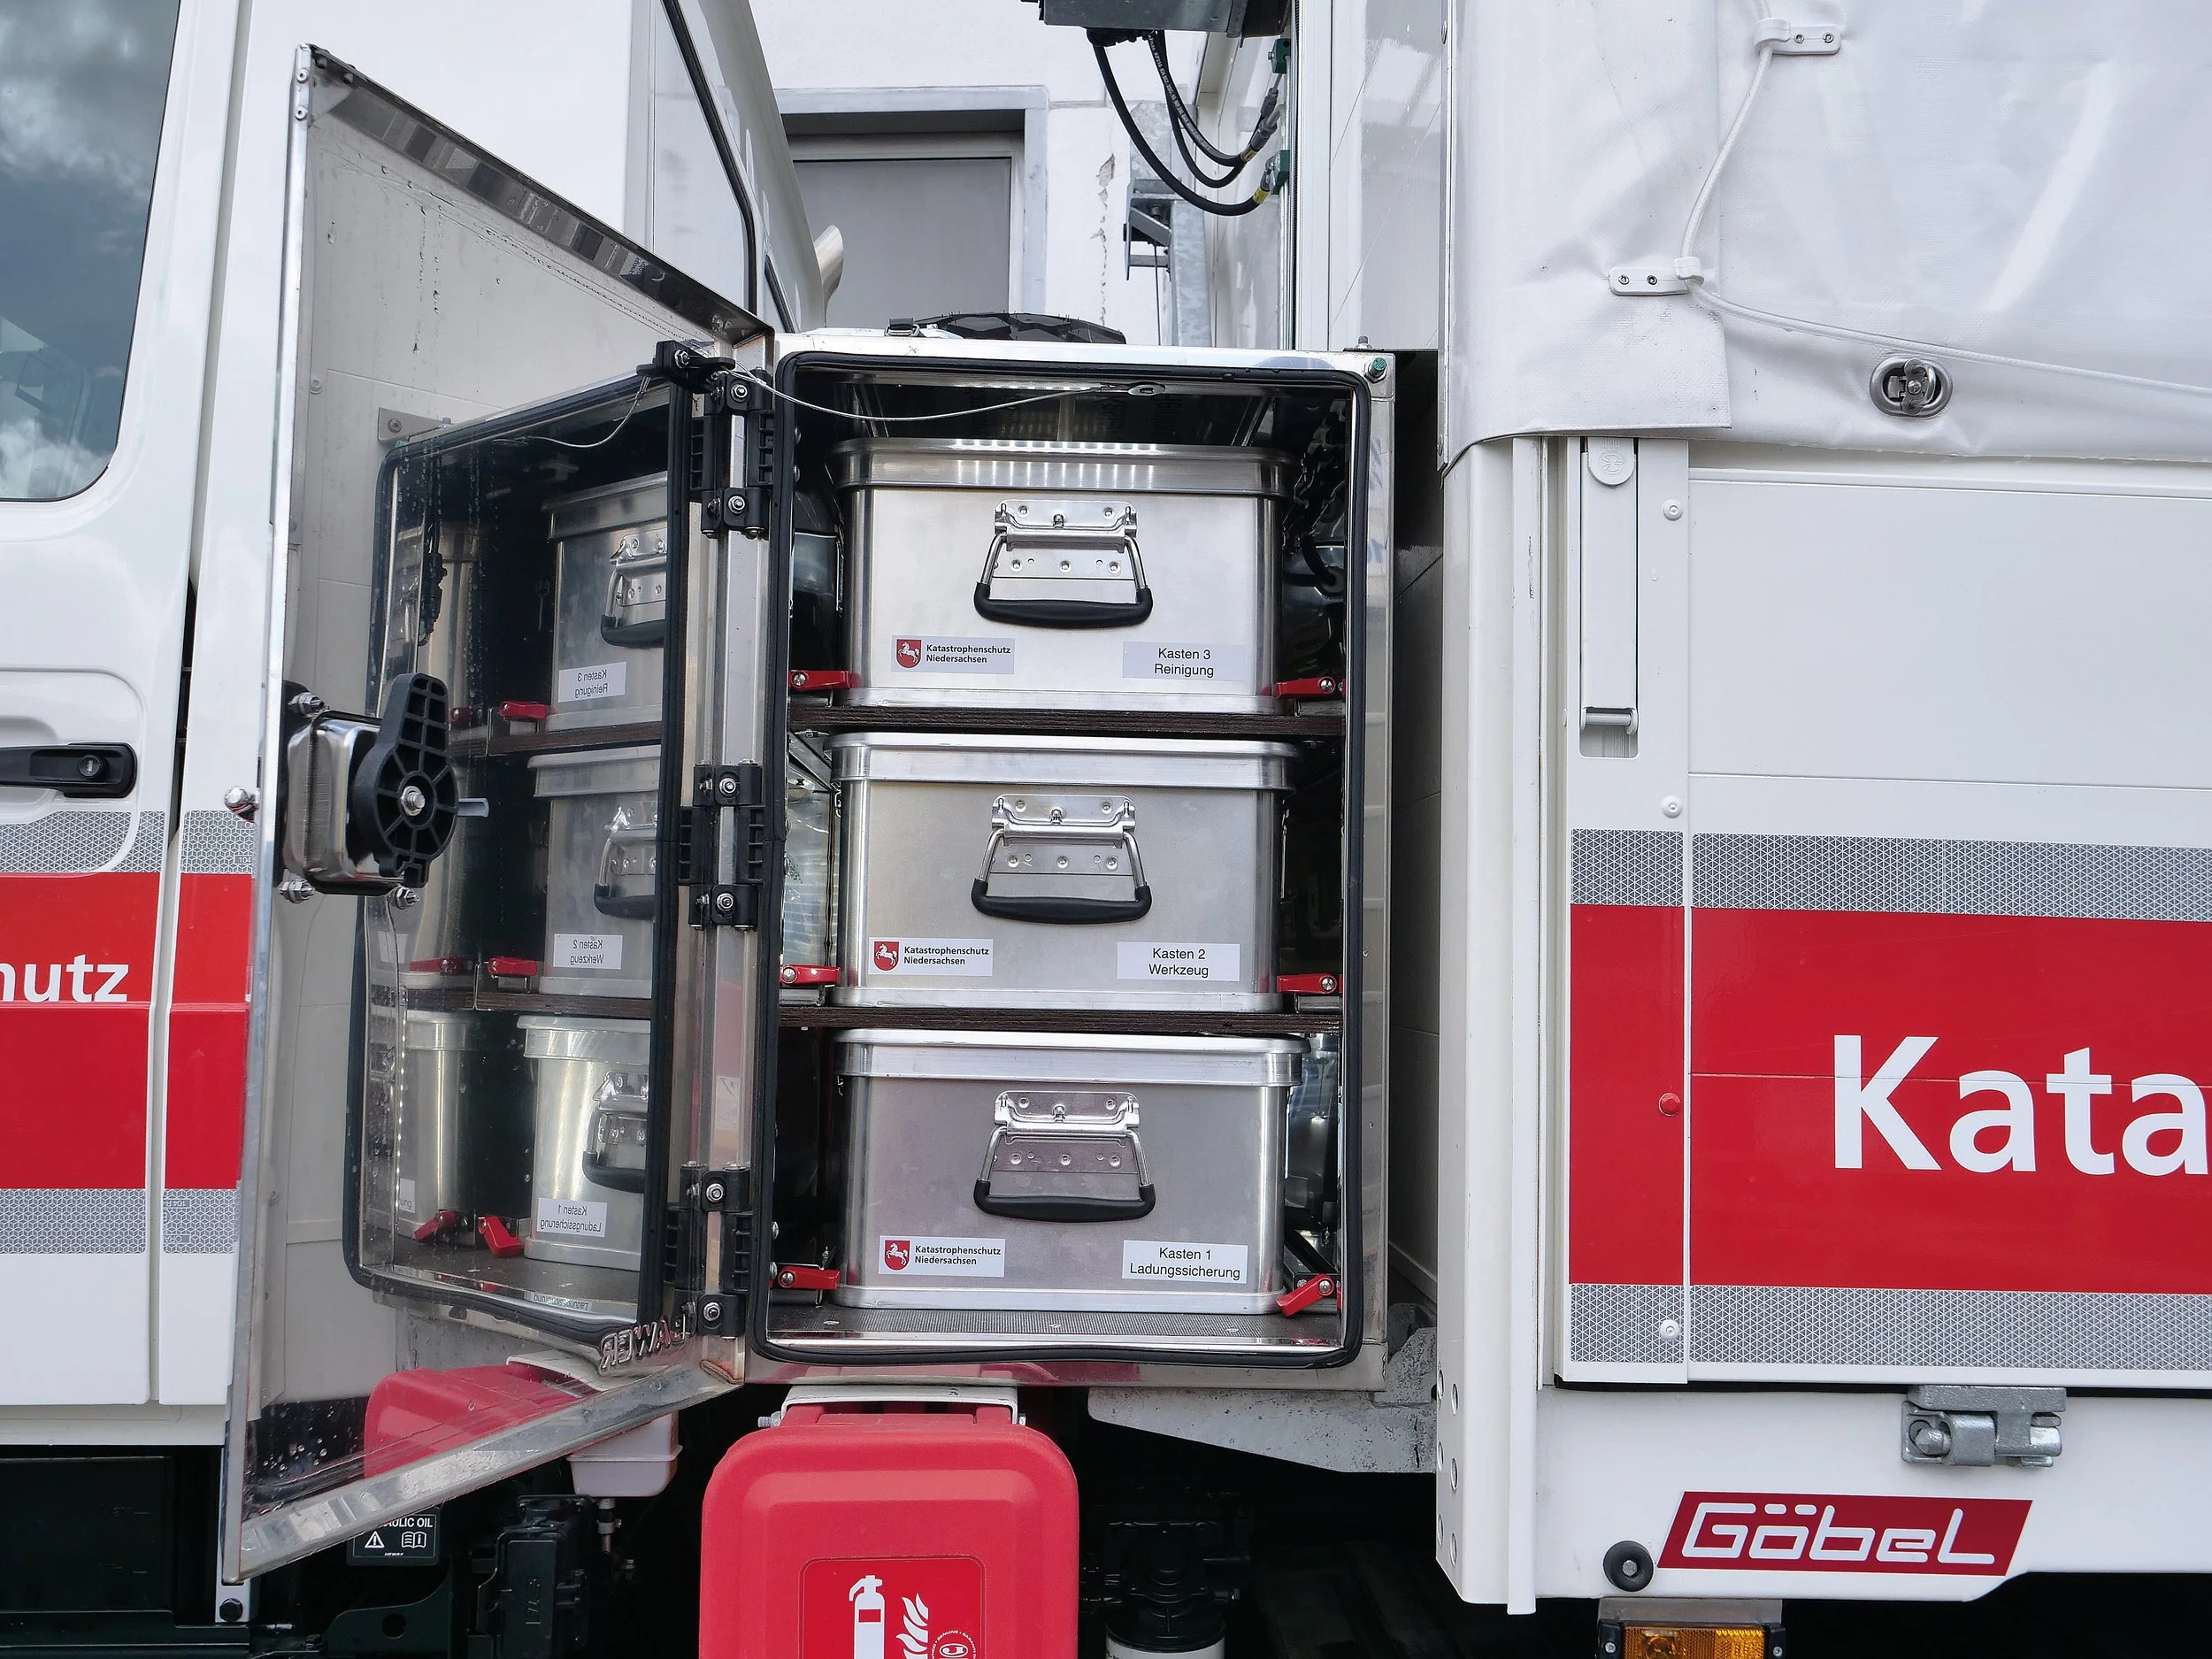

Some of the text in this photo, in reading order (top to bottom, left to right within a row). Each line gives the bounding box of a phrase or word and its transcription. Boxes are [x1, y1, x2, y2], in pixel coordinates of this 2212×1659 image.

[926, 644, 1010, 654] Katastrophenschutz
[1158, 648, 1210, 659] Kasten 3
[1155, 664, 1214, 678] Reinigung
[904, 946, 989, 956] Katastrophenschutz
[1153, 948, 1206, 959] Kasten 2
[1148, 964, 1209, 978] Werkzeug
[1834, 1034, 2208, 1176] Kata
[915, 1245, 1001, 1255] Katastrophenschutz
[1159, 1247, 1211, 1260] Kasten 1
[915, 1256, 977, 1264] Niedersachsen
[1130, 1263, 1240, 1280] Ladungssicherung
[417, 1517, 434, 1527] OIL
